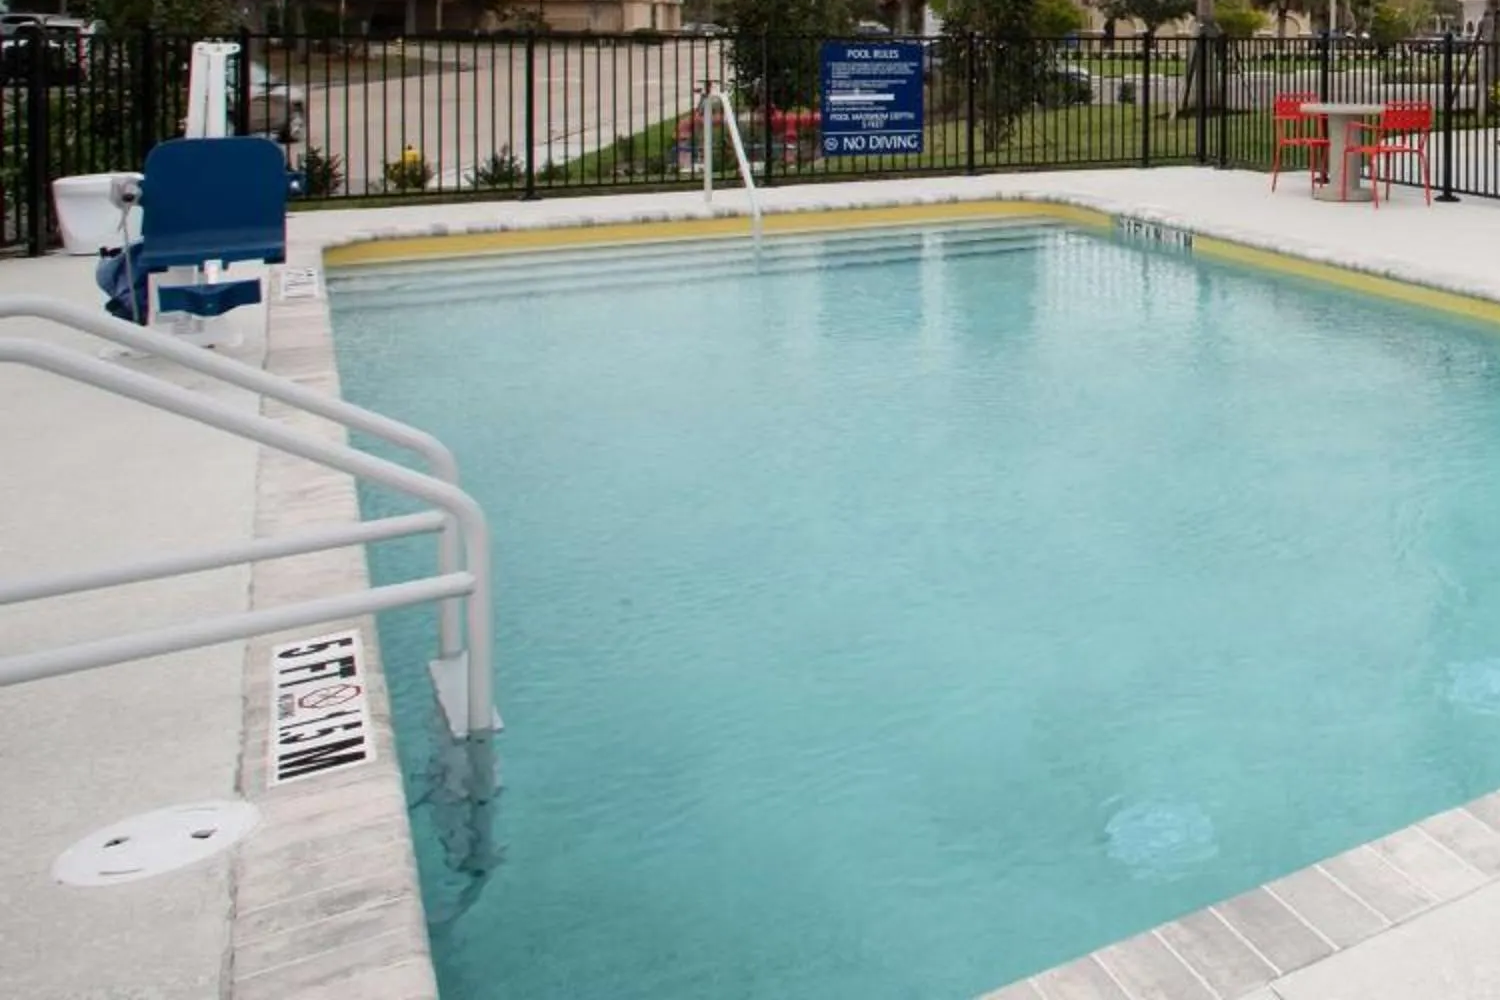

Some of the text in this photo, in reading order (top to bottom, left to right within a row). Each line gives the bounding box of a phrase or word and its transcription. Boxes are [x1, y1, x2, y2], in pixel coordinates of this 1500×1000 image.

[846, 48, 900, 59] POOL RULES
[843, 133, 919, 151] NO DIVING
